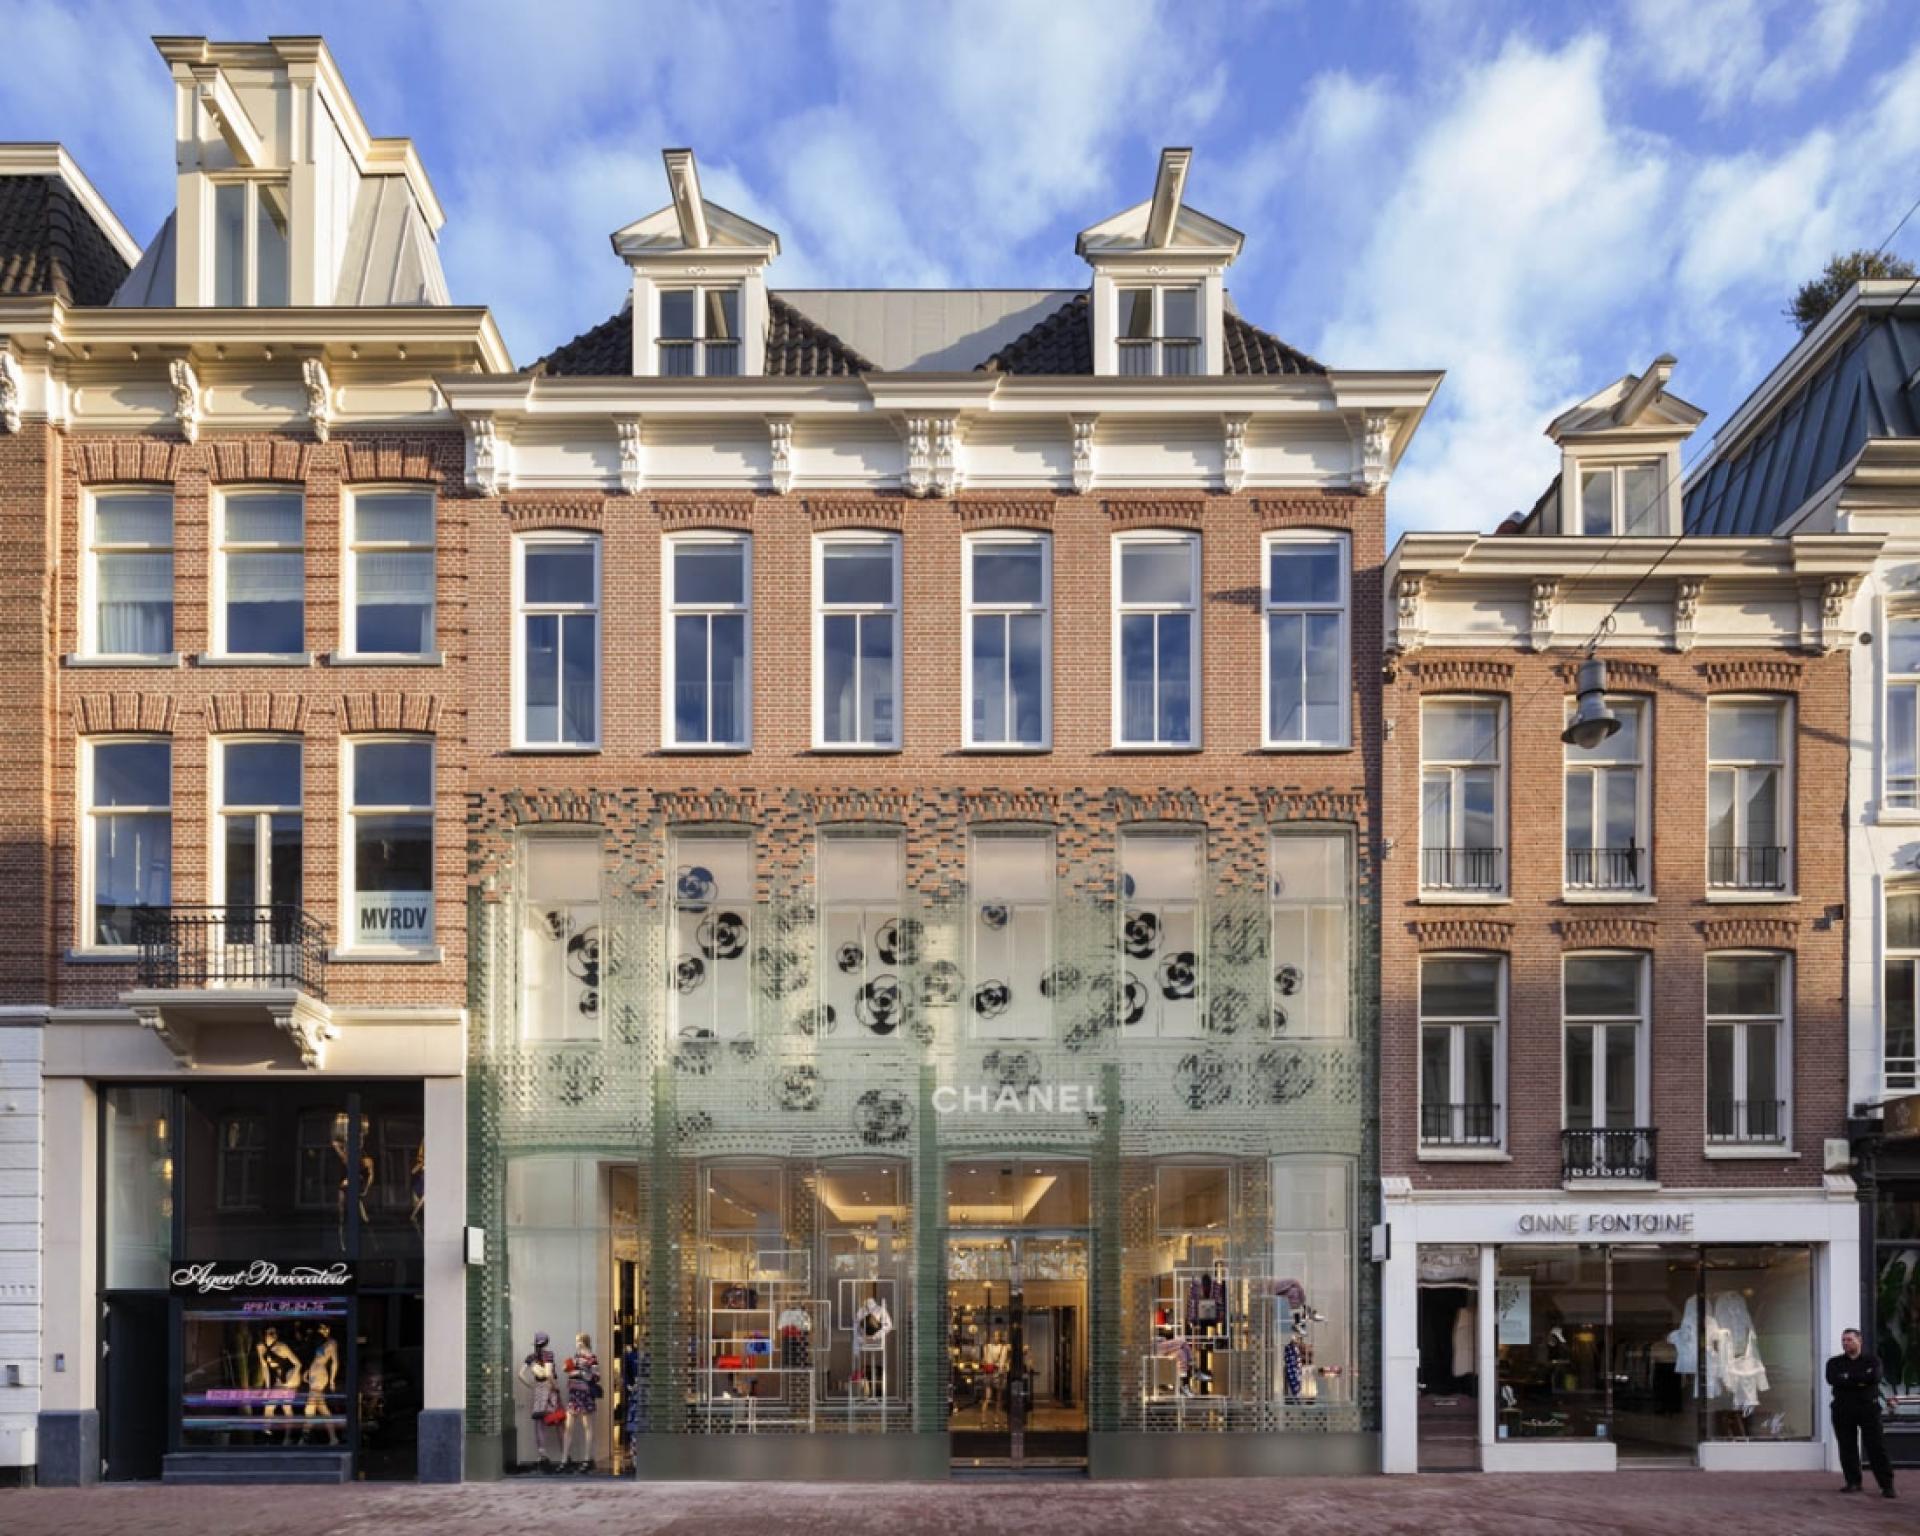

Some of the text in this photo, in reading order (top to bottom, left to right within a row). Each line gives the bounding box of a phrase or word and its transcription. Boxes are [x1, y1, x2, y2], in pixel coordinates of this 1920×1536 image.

[361, 907, 427, 930] MVRDV
[931, 1085, 1107, 1113] CHANEL
[172, 1259, 352, 1294] Agent Provocateur
